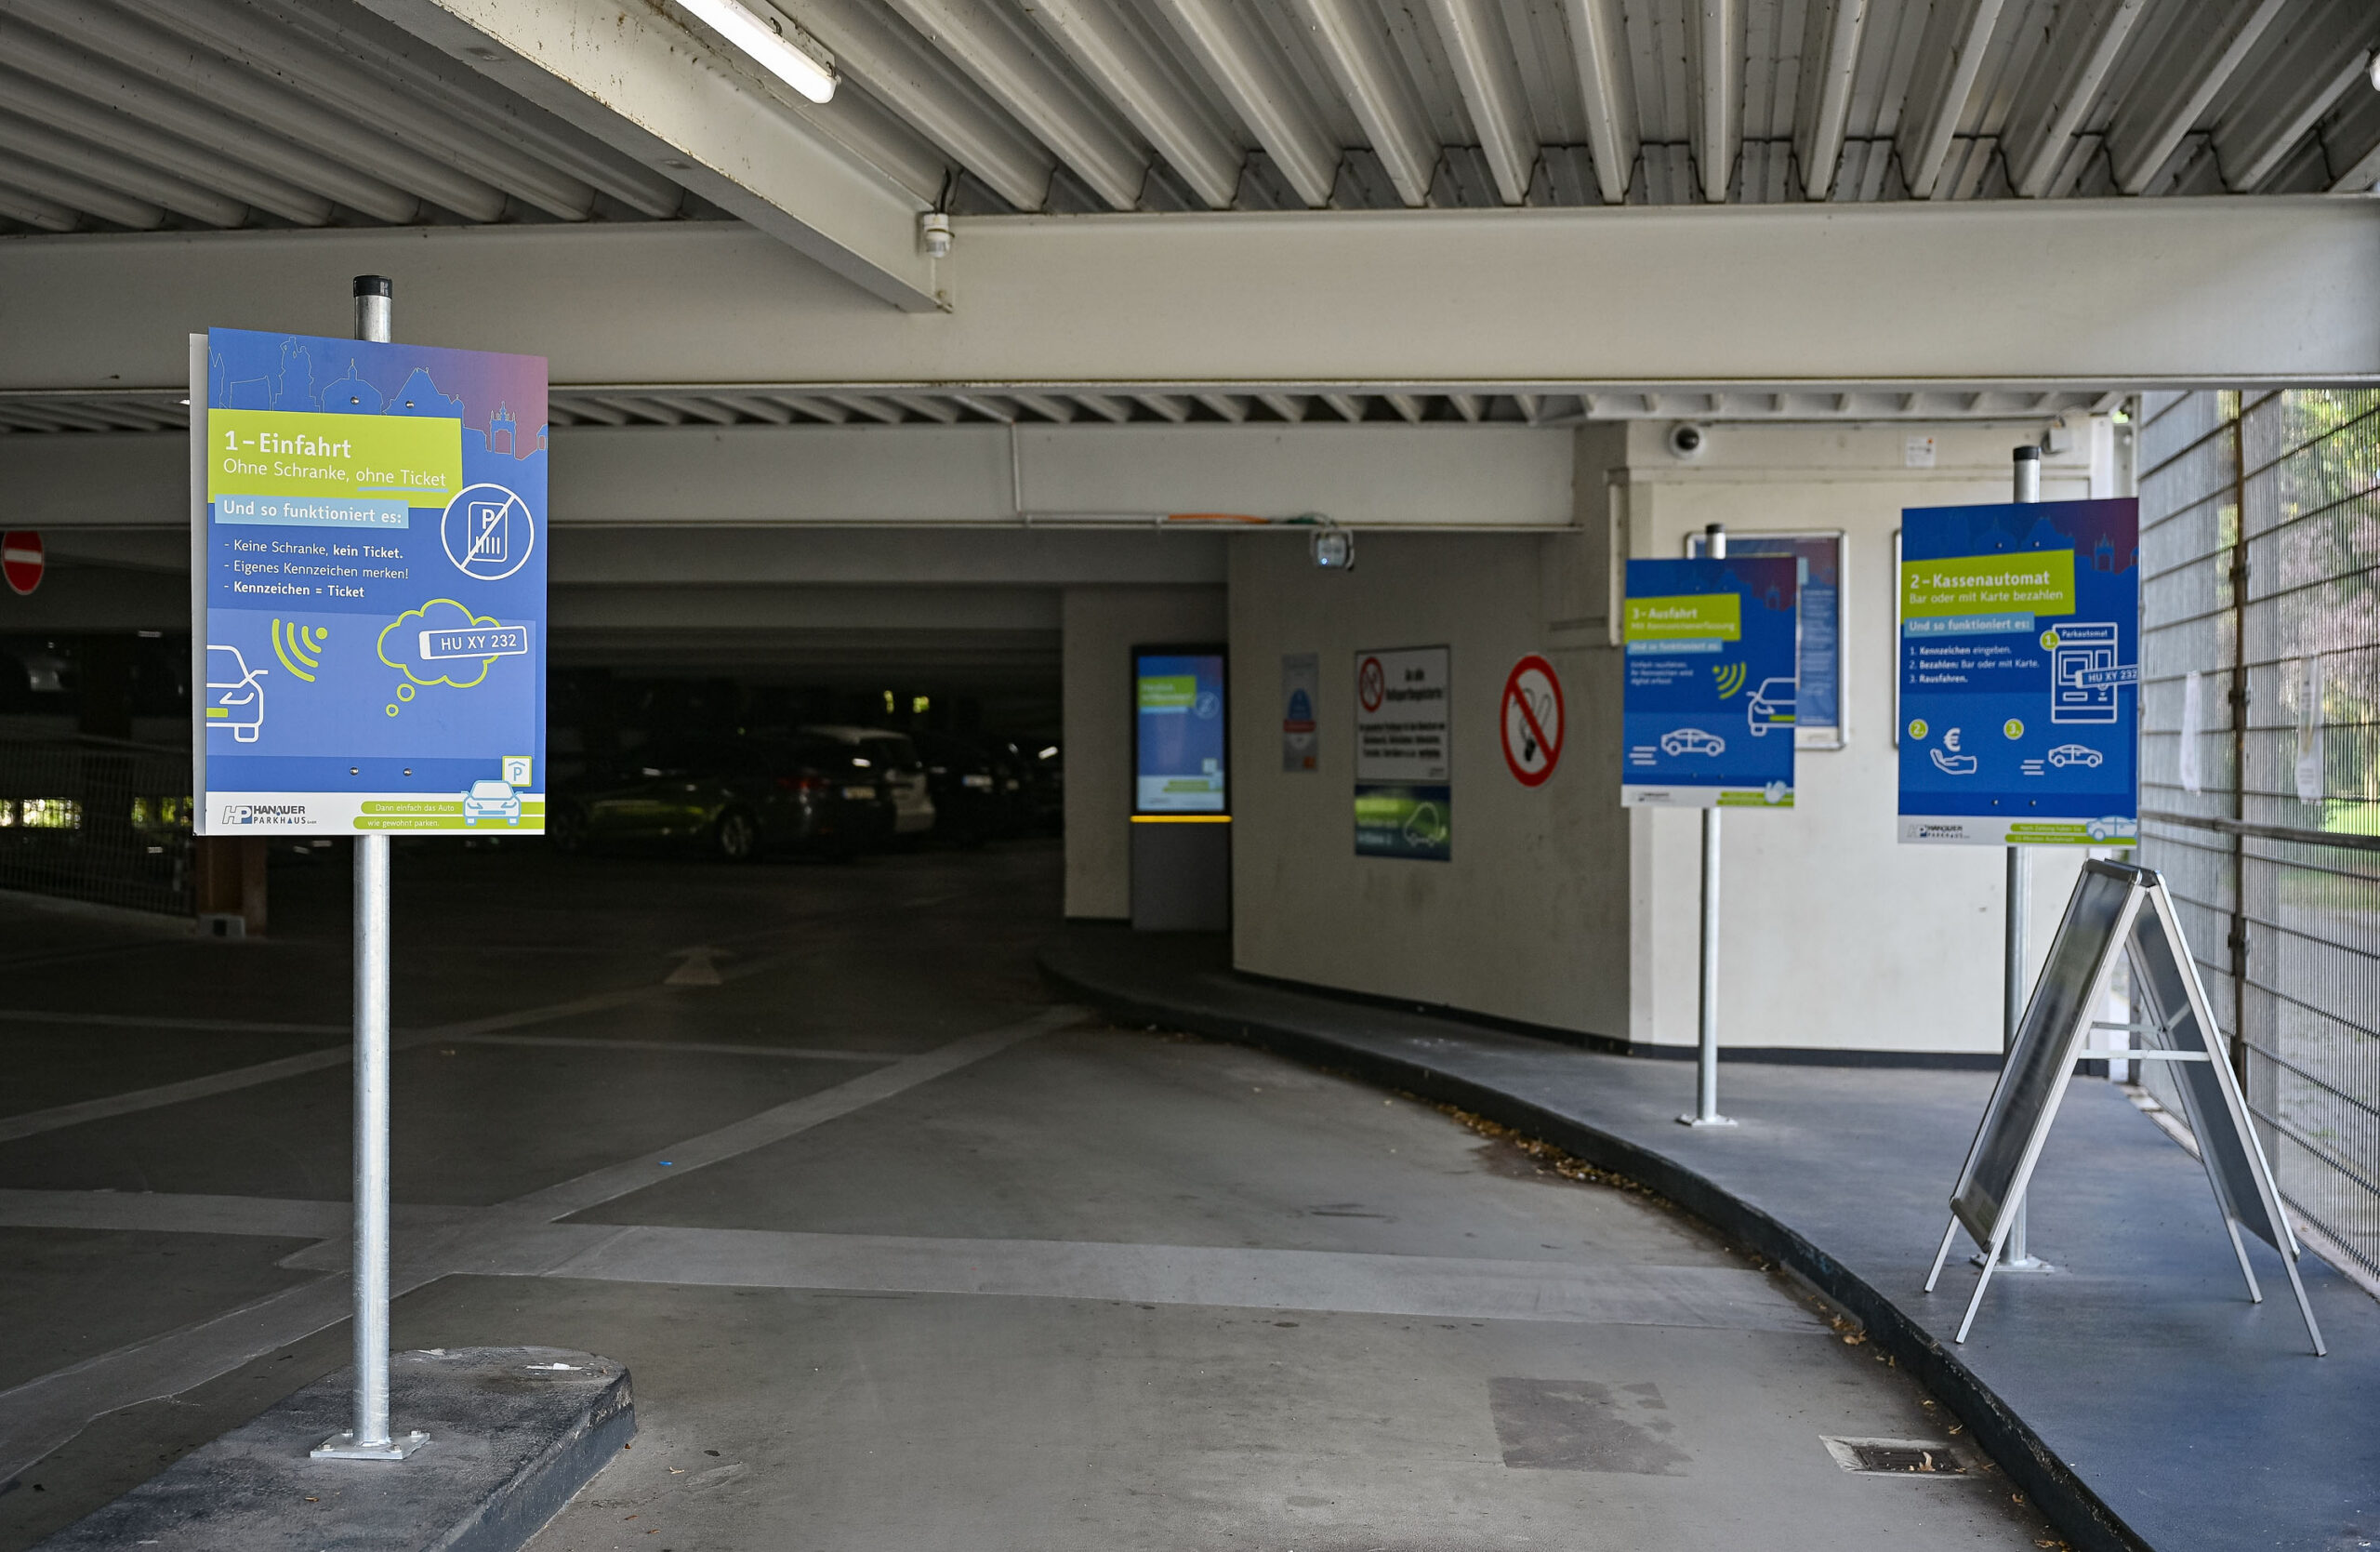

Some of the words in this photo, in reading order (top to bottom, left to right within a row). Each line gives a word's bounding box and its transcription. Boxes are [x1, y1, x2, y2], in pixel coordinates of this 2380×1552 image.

[223, 458, 268, 475] Ohne
[274, 461, 350, 483] Schranke,
[356, 467, 394, 483] ohne
[401, 469, 446, 486] Ticket
[223, 499, 255, 516] Und
[260, 505, 277, 516] so
[284, 502, 376, 523] funktioniert
[381, 512, 402, 524] es:
[234, 539, 268, 552] Keine
[271, 541, 329, 557] Schranke,
[333, 544, 359, 557] kein
[363, 546, 403, 559] Ticket.
[234, 560, 279, 576] Eigenes
[284, 563, 358, 577] Kennzeichen
[363, 567, 409, 579] merken!
[234, 581, 311, 595] Kennzeichen
[327, 585, 365, 598] Ticket
[1910, 593, 1926, 604] Bar
[1931, 592, 1955, 604] oder
[1959, 591, 1977, 603] mit
[1980, 590, 2010, 602] Karte
[2014, 590, 2063, 601] bezahlen
[1910, 620, 1930, 630] Und
[1933, 621, 1945, 630] so
[1949, 618, 2011, 630] funktioniert
[2015, 619, 2030, 629] es:
[2062, 630, 2108, 638] Parkautomat
[441, 635, 462, 651] HU
[468, 635, 486, 650] XY
[490, 633, 518, 649] 232
[1920, 645, 1971, 656] Kennzeichen
[1972, 645, 2012, 657] eingeben.
[1920, 659, 1959, 670] Bezahlen:
[1961, 659, 1975, 669] Bar
[1977, 658, 1995, 669] oder
[1998, 658, 2013, 669] mit
[2015, 658, 2040, 668] Karte.
[1919, 673, 1968, 683] Rausfahren.
[2088, 672, 2102, 683] HU
[2106, 671, 2118, 681] XY
[254, 805, 306, 816] HANAUER
[376, 803, 394, 812] Dann
[396, 803, 422, 812] einfach
[424, 803, 436, 812] das
[438, 803, 455, 812] Auto
[382, 819, 412, 829] gewohnt
[415, 819, 440, 829] parken.
